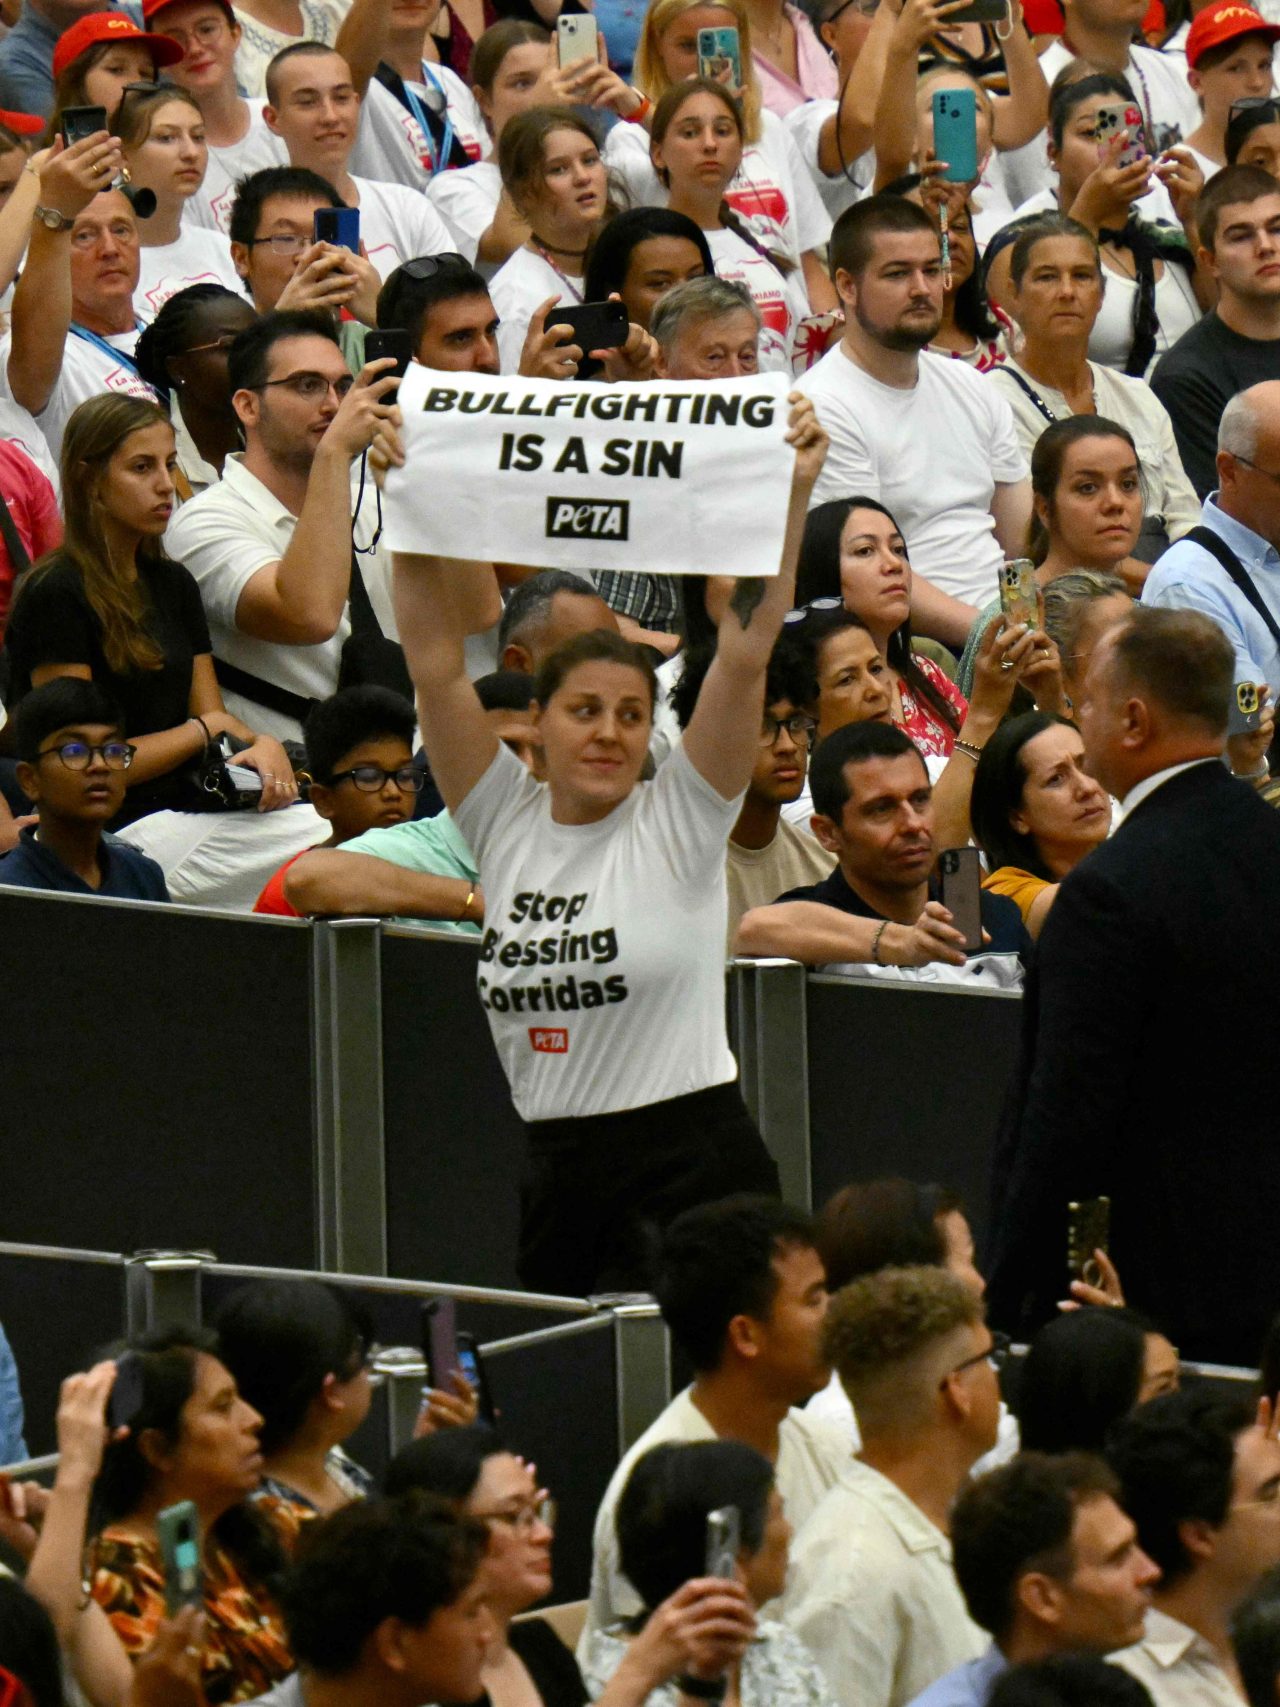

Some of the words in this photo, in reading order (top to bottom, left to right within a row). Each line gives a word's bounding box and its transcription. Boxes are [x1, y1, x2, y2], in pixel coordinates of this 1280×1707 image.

[423, 386, 776, 429] BULLFIGHTING
[498, 432, 545, 472] IS
[554, 437, 589, 474] A
[600, 438, 685, 479] SIN
[508, 889, 589, 925] Stop
[479, 926, 619, 968] Bessing
